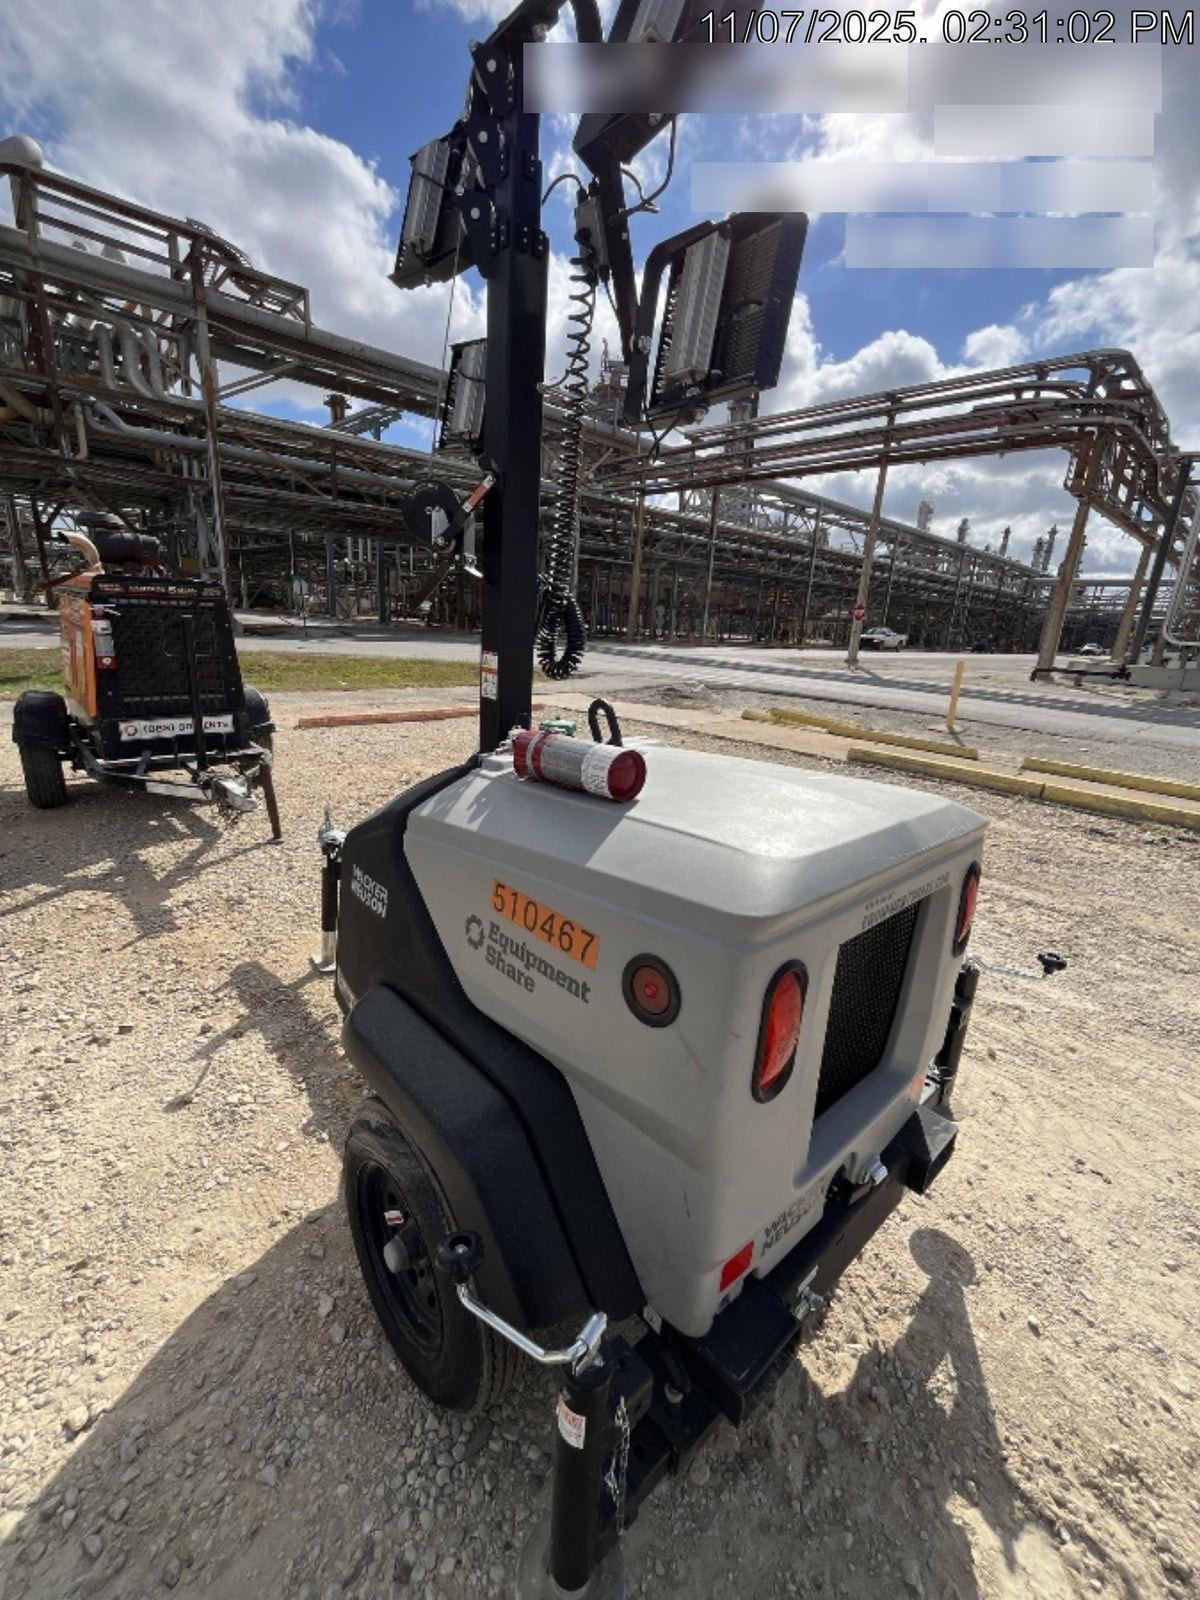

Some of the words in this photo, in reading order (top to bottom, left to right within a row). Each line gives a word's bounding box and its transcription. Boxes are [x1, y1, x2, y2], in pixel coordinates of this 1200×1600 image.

[487, 921, 591, 1004] Equipment
[493, 882, 596, 963] 510467
[485, 945, 536, 994] Share
